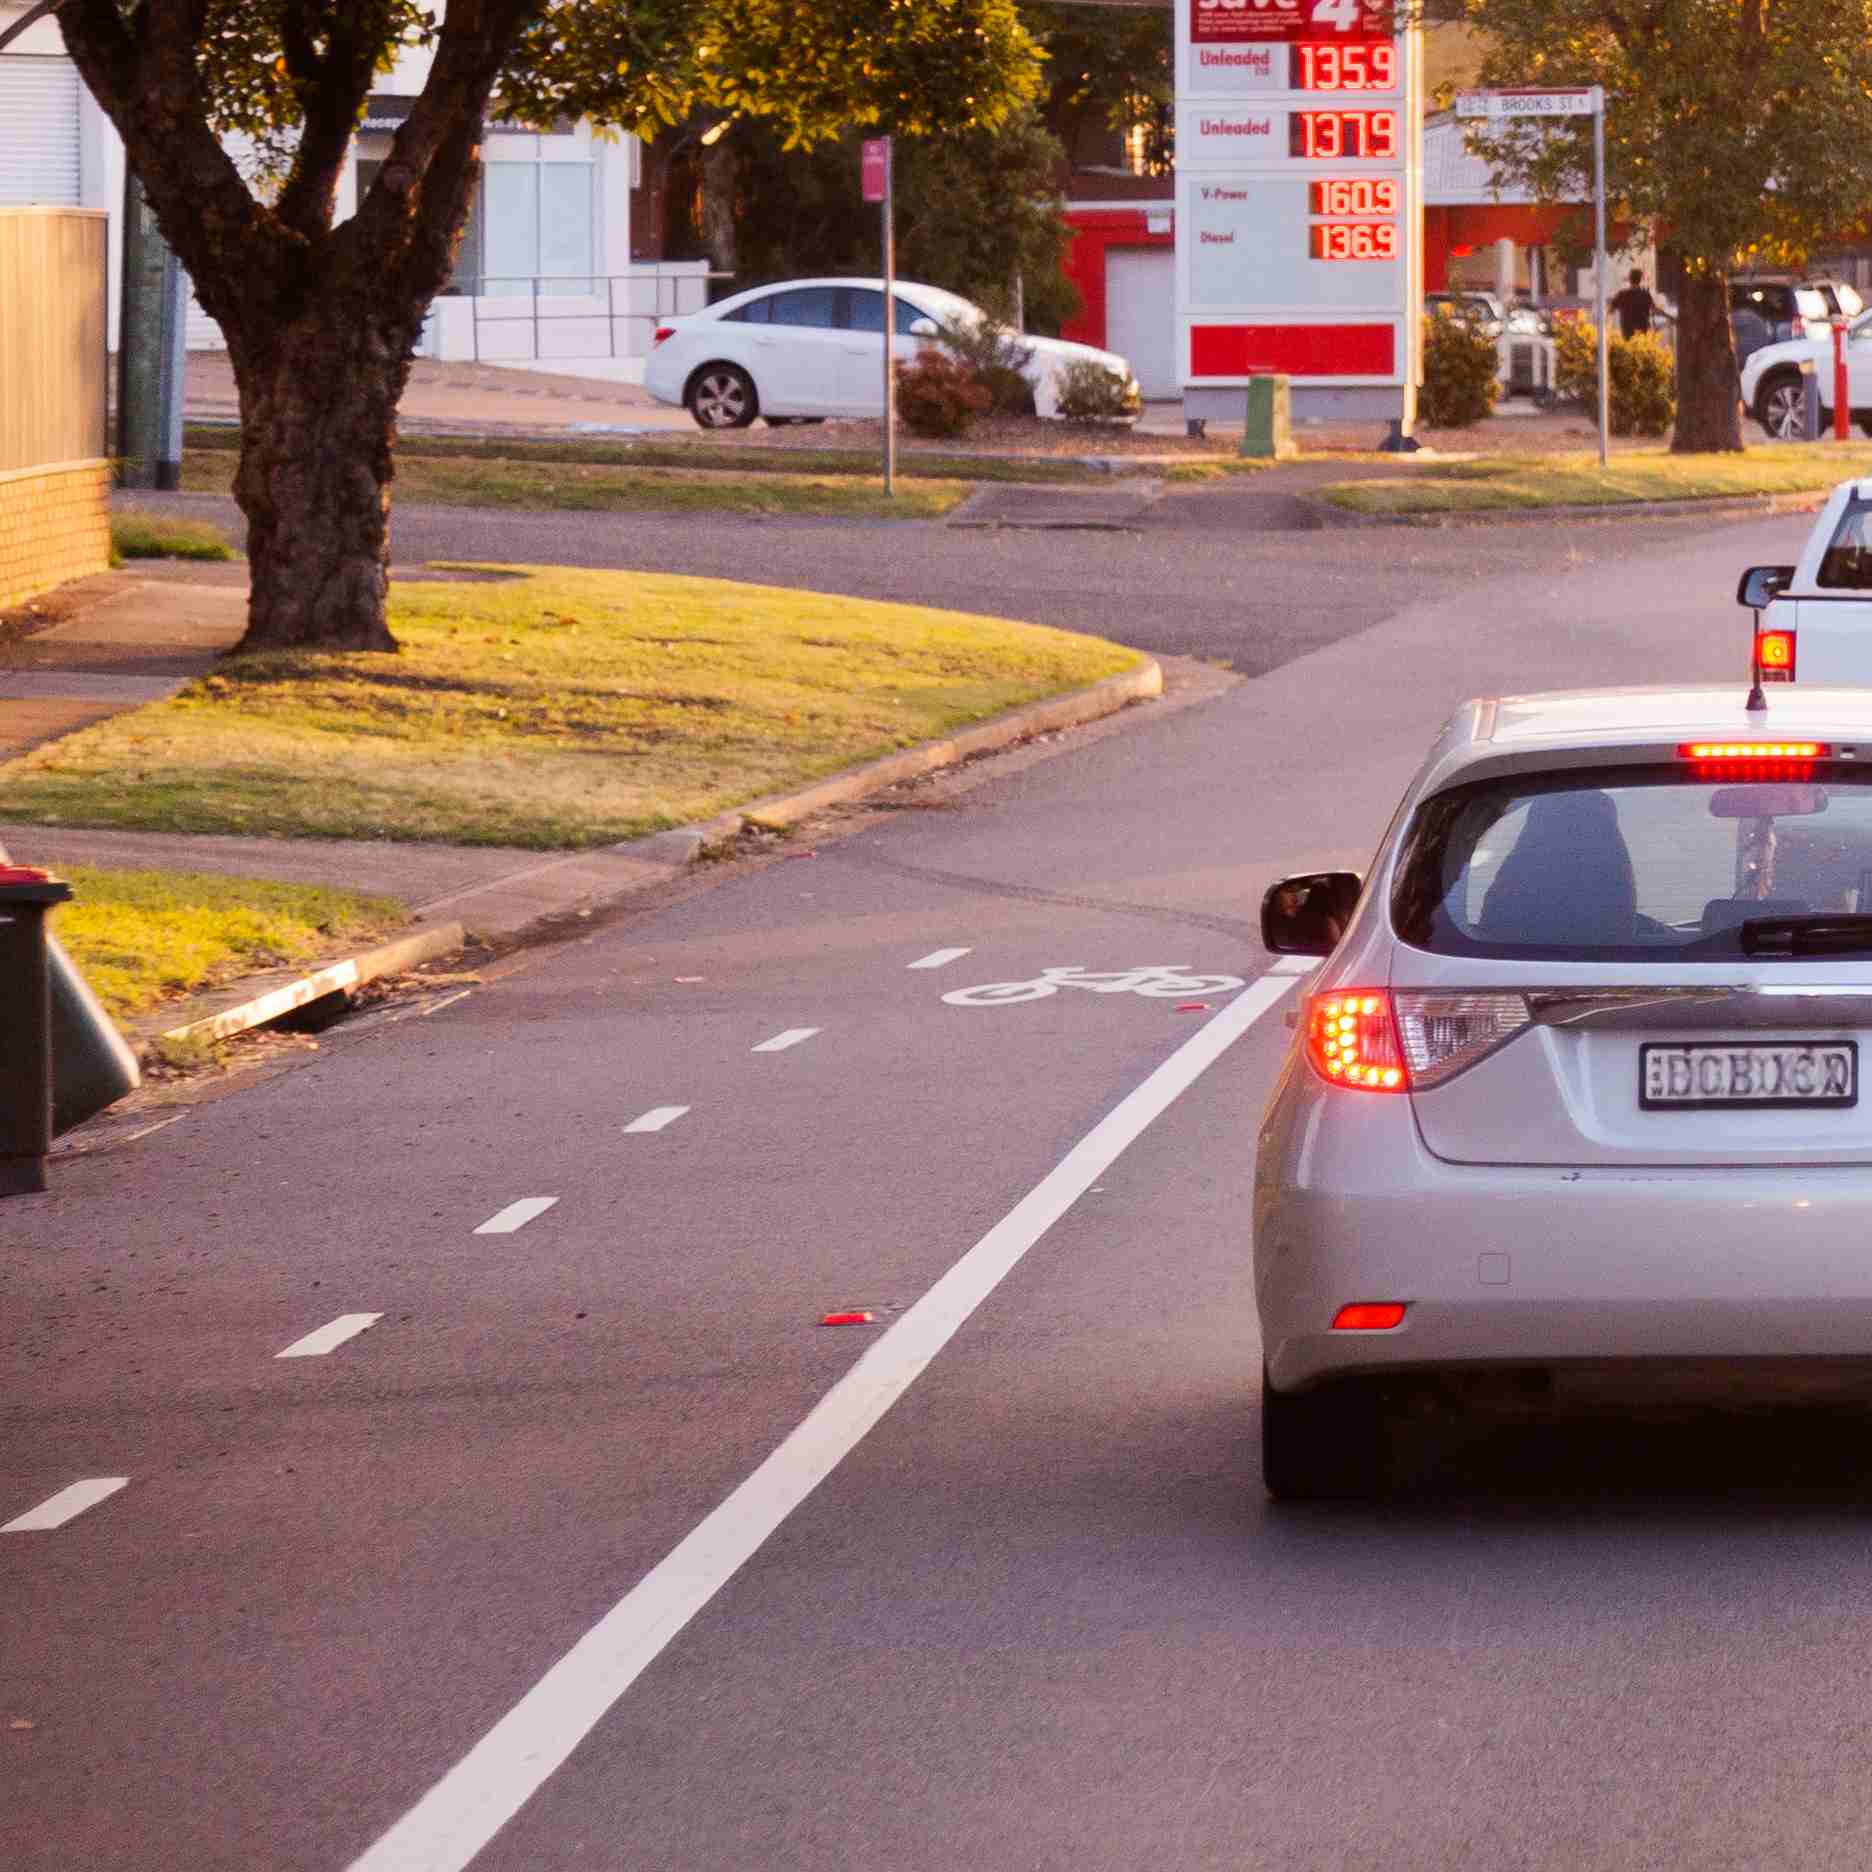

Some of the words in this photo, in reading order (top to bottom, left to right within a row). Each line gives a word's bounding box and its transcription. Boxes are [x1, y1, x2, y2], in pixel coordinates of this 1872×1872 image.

[1200, 50, 1270, 66] Unleaded
[1301, 46, 1395, 89] 135.9
[1502, 97, 1552, 111] BROOKS
[1200, 119, 1270, 136] Unleaded
[1319, 181, 1397, 215] 160.9
[1200, 232, 1234, 244] Diesel
[1319, 225, 1397, 259] 136.9
